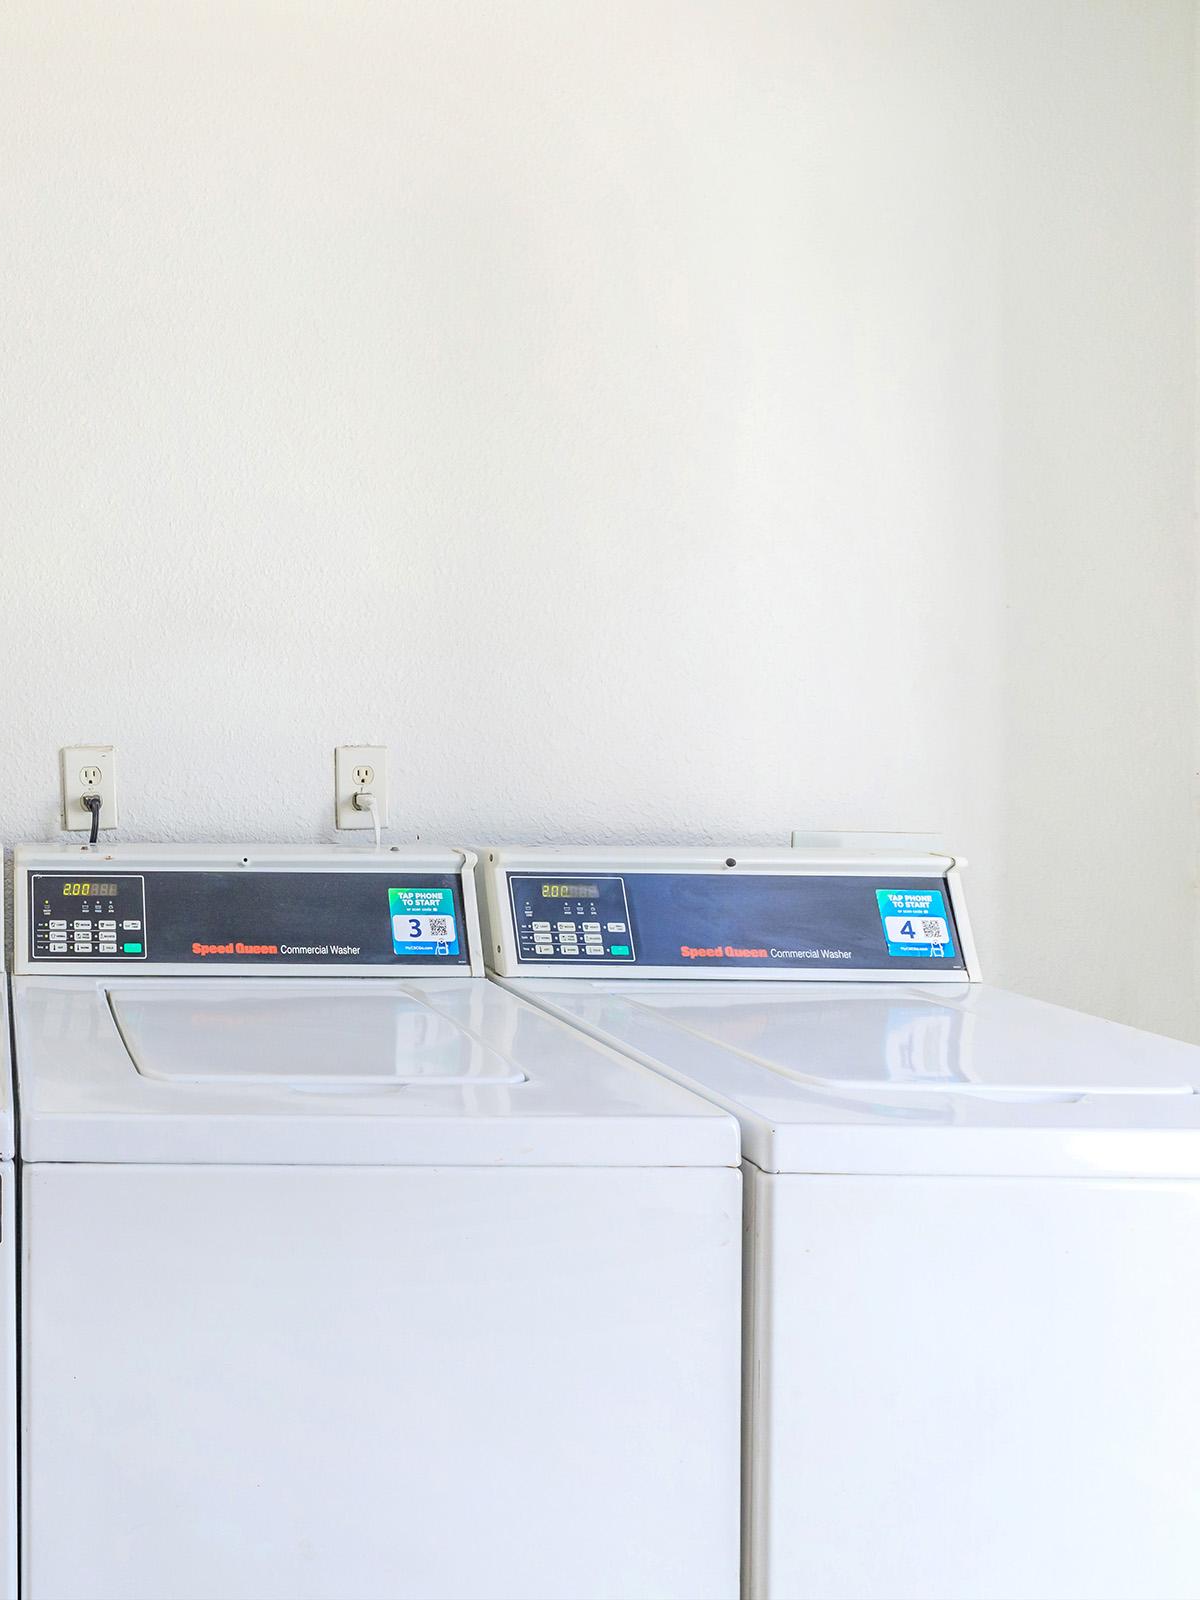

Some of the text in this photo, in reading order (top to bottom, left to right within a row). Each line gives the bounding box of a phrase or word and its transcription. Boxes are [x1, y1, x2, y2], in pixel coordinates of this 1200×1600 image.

[63, 884, 90, 896] 2.00
[409, 919, 422, 937] 3
[900, 921, 916, 938] 4
[192, 942, 360, 956] Speed Queen Commercial Washer
[681, 946, 852, 959] Speed Queen Commercial Washer
